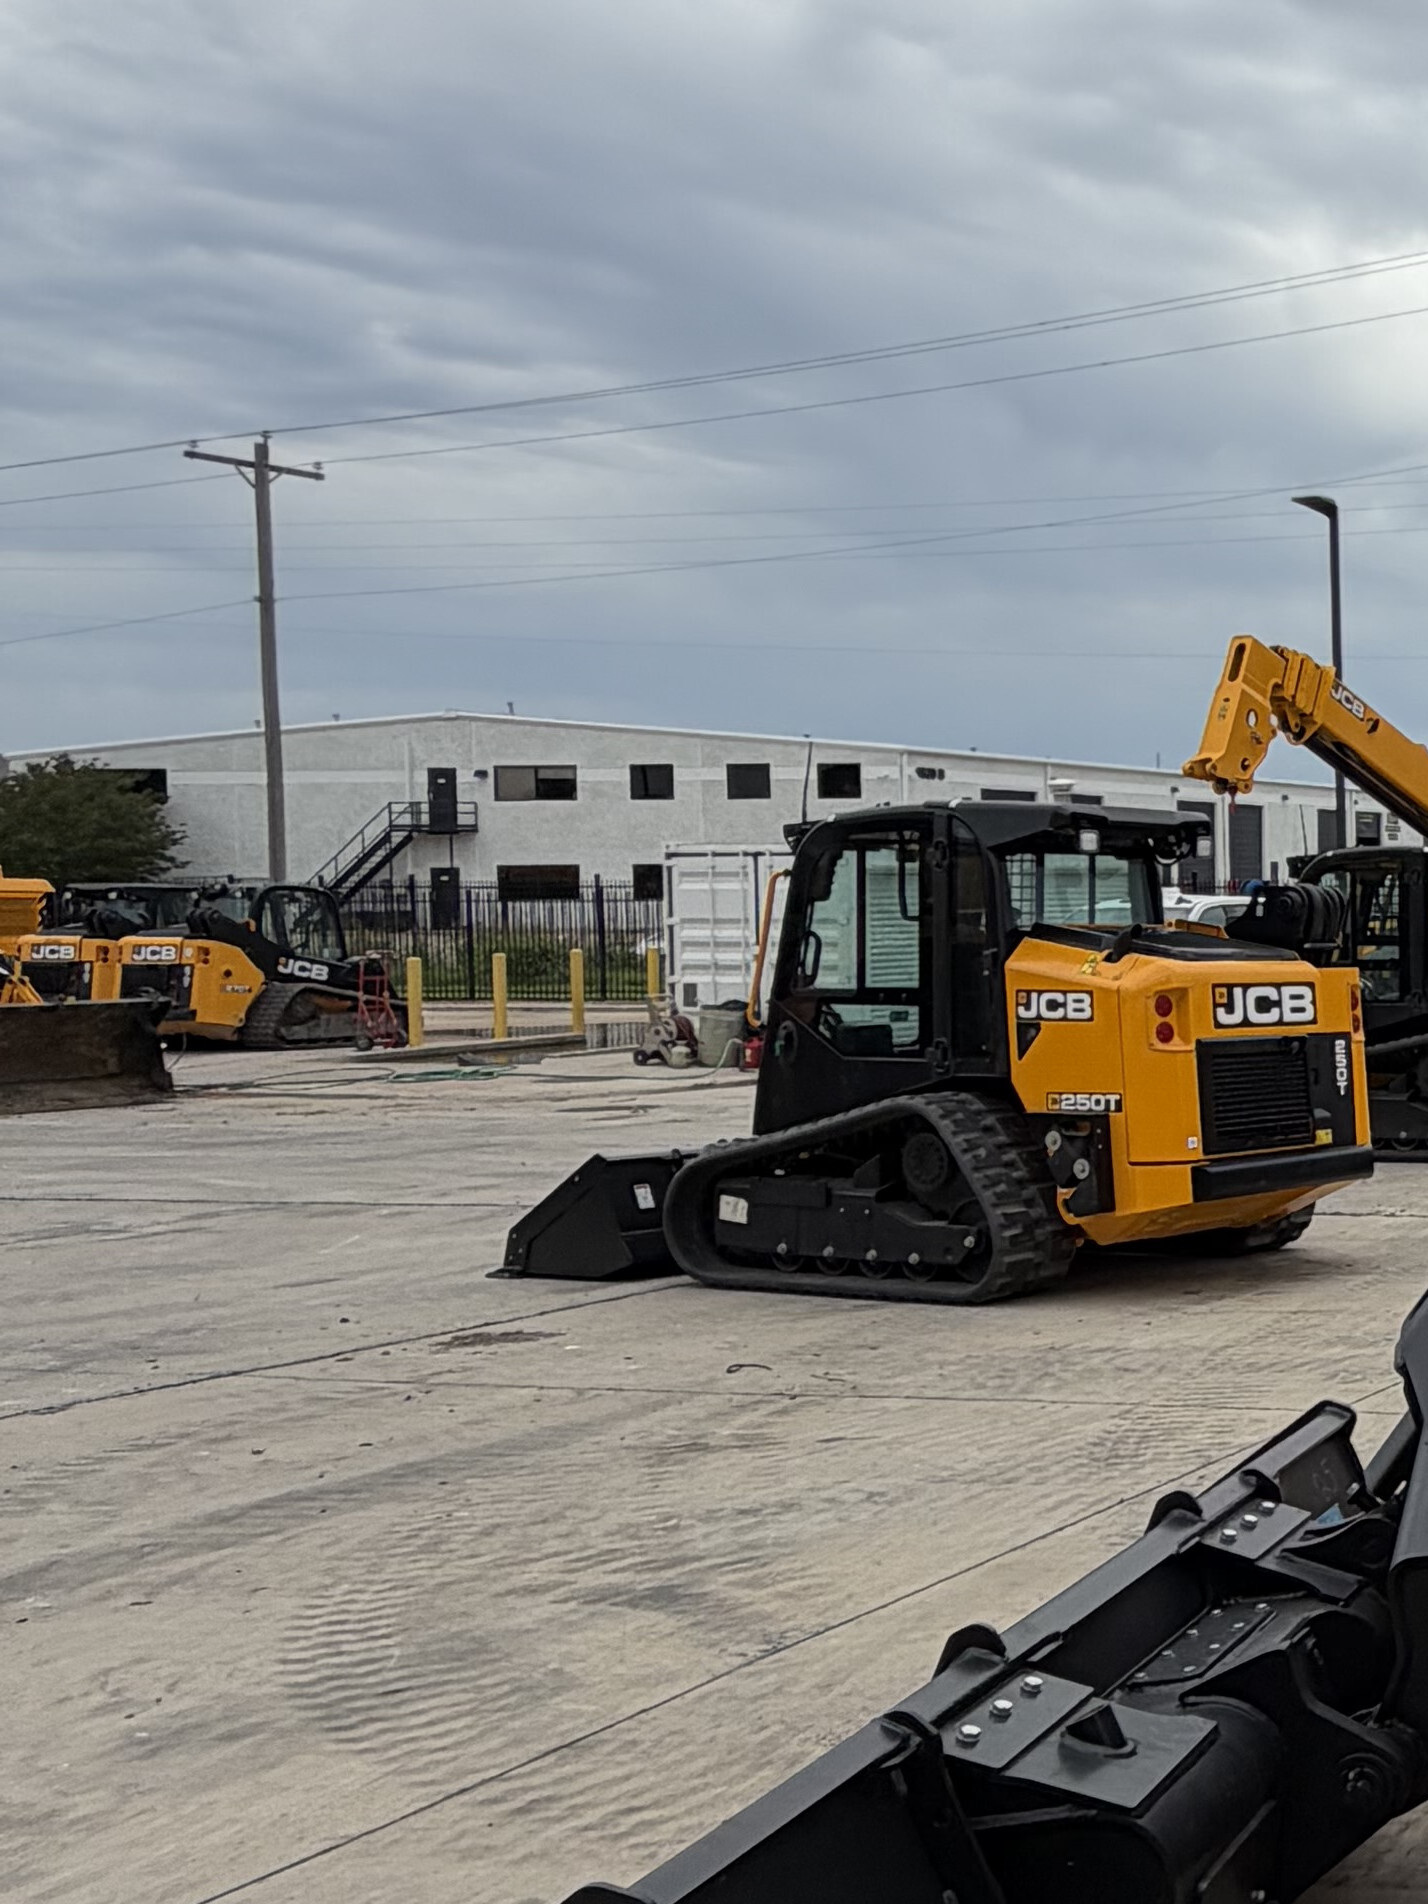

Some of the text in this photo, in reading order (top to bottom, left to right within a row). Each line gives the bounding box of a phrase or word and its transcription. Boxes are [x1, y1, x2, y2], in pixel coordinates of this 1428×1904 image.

[1331, 686, 1365, 718] JCB
[32, 945, 75, 959] JCB
[132, 946, 176, 960] JCB
[277, 957, 329, 981] JCB
[1017, 992, 1093, 1019] JCB
[1216, 985, 1315, 1026] JCB
[1335, 1039, 1348, 1096] 250T
[1061, 1094, 1120, 1111] 250T
